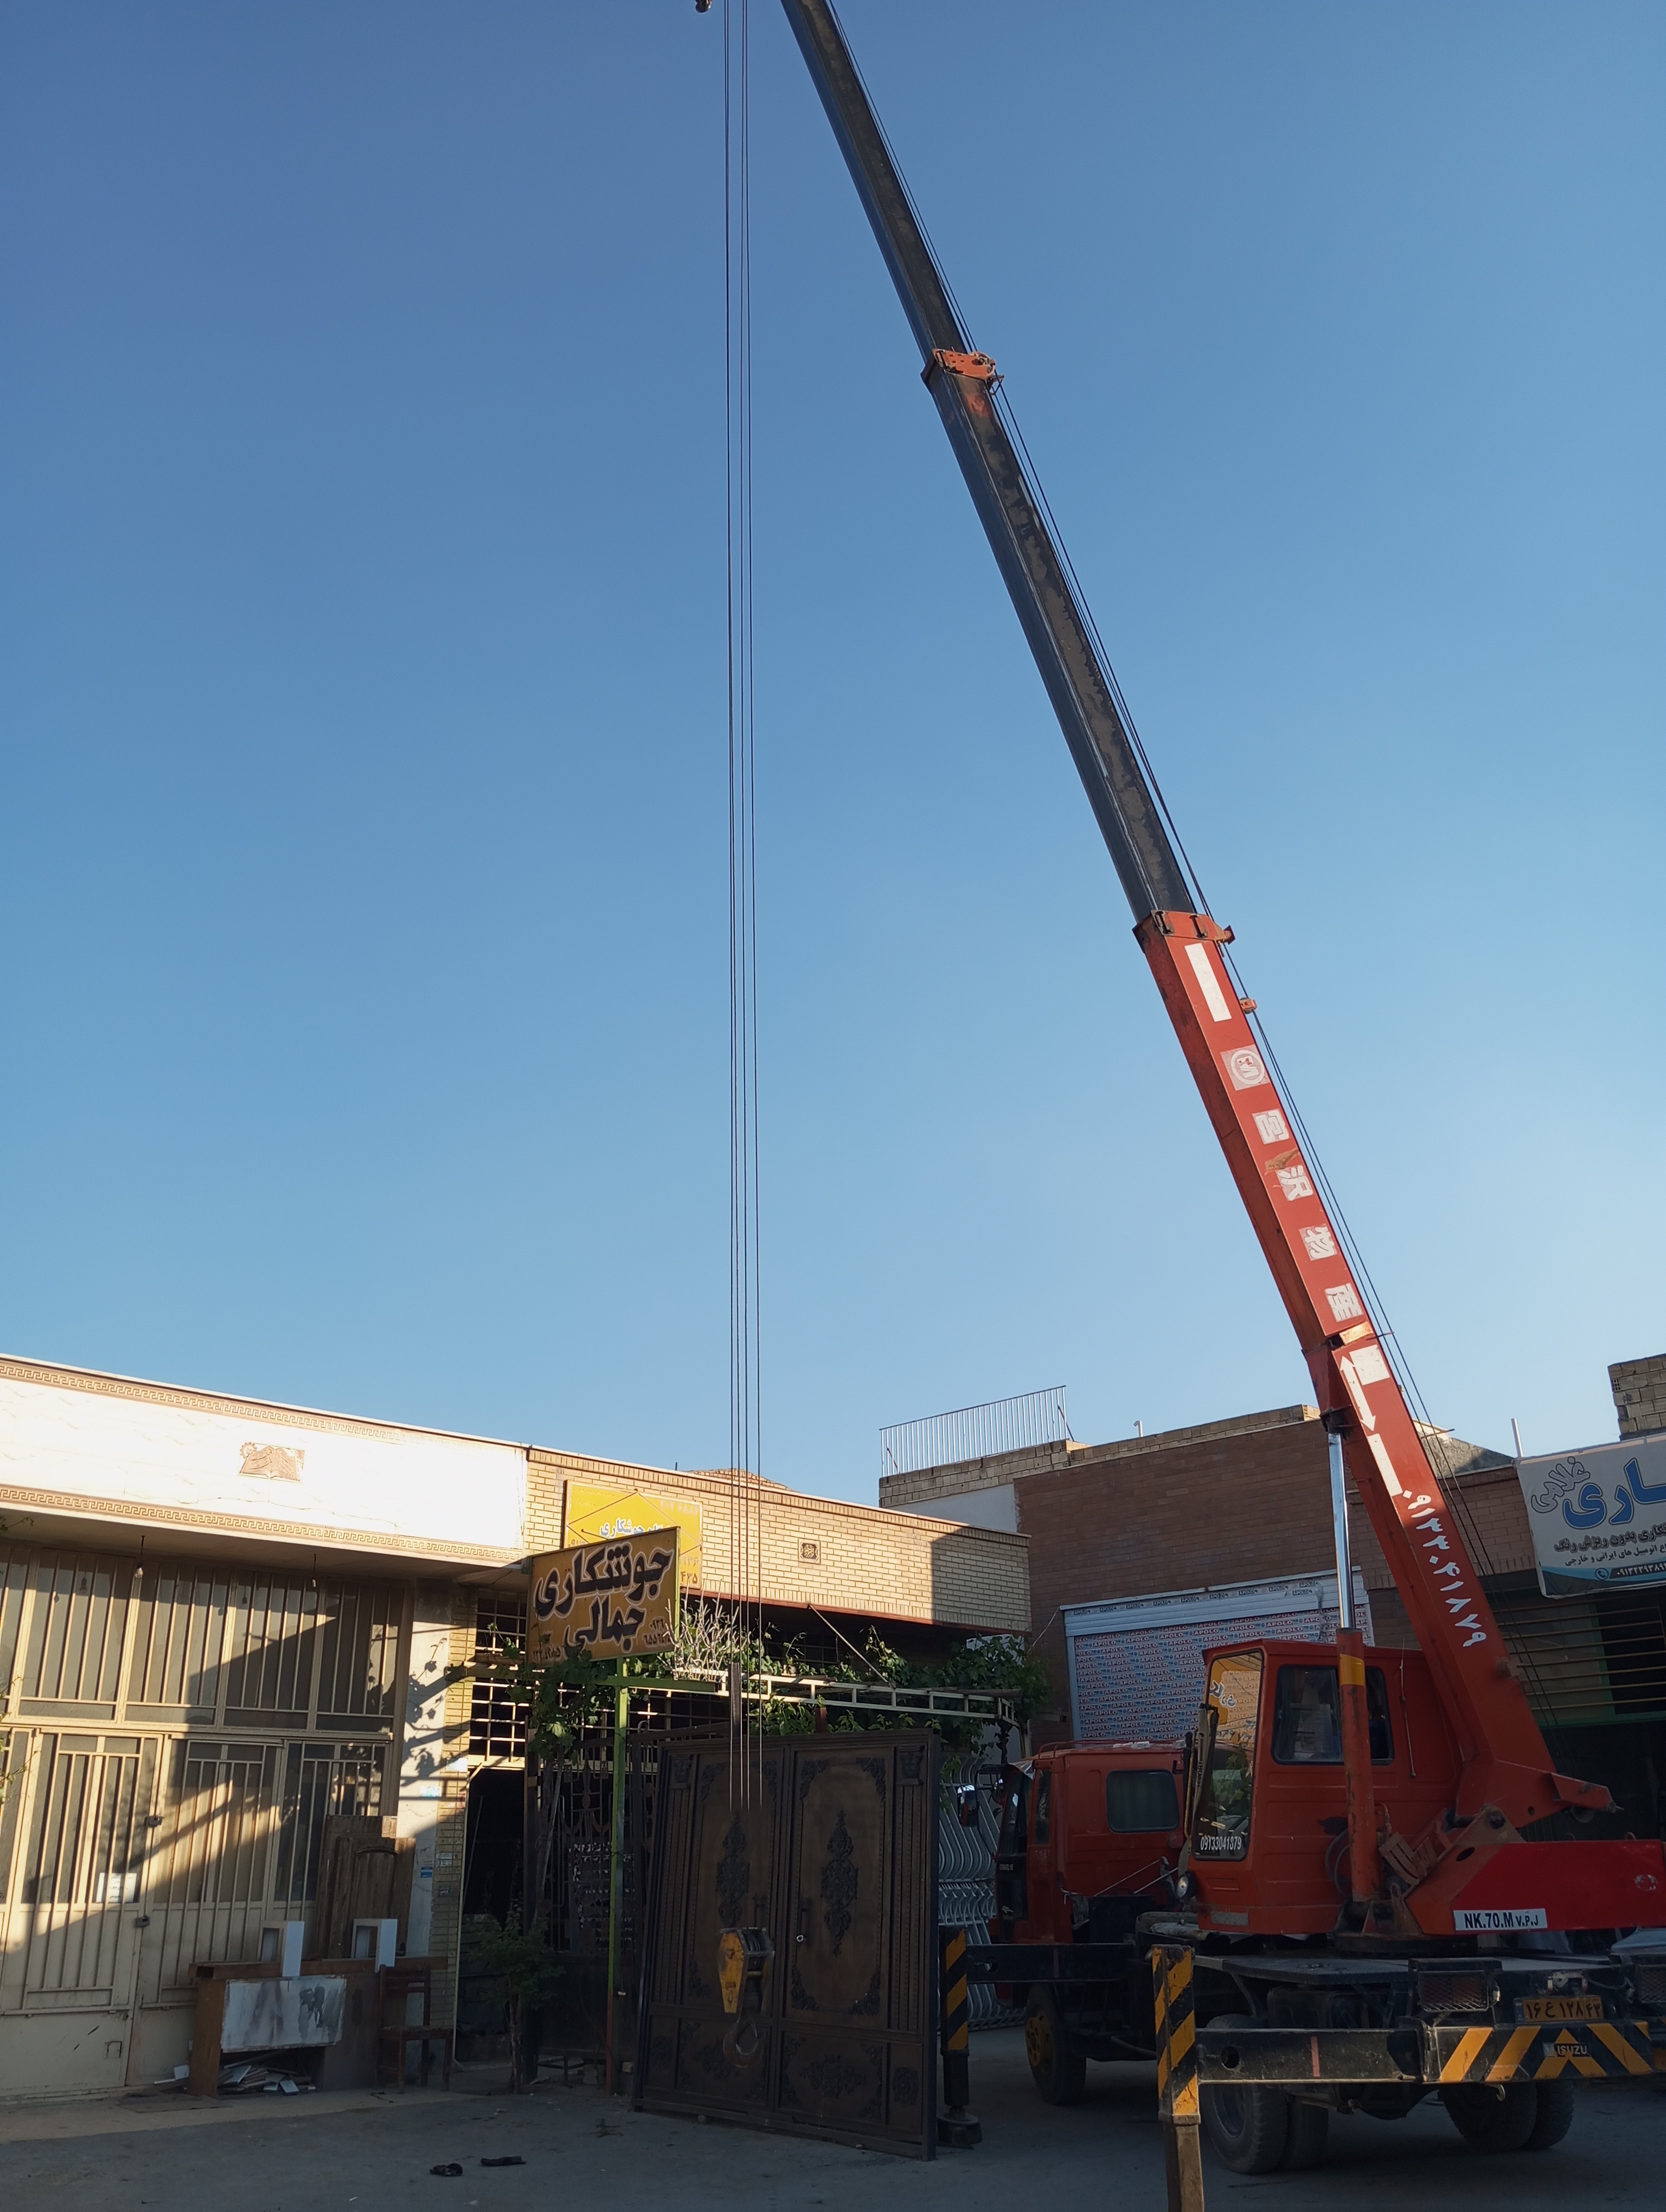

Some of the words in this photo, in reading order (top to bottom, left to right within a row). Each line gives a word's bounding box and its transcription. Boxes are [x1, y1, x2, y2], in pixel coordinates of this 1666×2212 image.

[1531, 1456, 1591, 1513] غلامی
[1554, 1538, 1578, 1553] رنگ
[1578, 1535, 1609, 1551] ریزش
[1609, 1531, 1637, 1547] بدون
[1596, 1551, 1617, 1561] ایرانی
[1619, 1549, 1632, 1559] های
[1634, 1545, 1657, 1557] اتومبیل
[1565, 1554, 1588, 1566] خارجی
[534, 1541, 674, 1619] جوشکاری
[565, 1594, 646, 1660] جمالی
[1200, 1836, 1241, 1850] 09133041879
[1464, 1912, 1514, 1928] NK.70.M
[1527, 2002, 1541, 2018] ۱۶
[1545, 2001, 1556, 2017] ع
[1586, 2003, 1601, 2017] ۴۳
[1556, 2045, 1587, 2055] ISUZU
